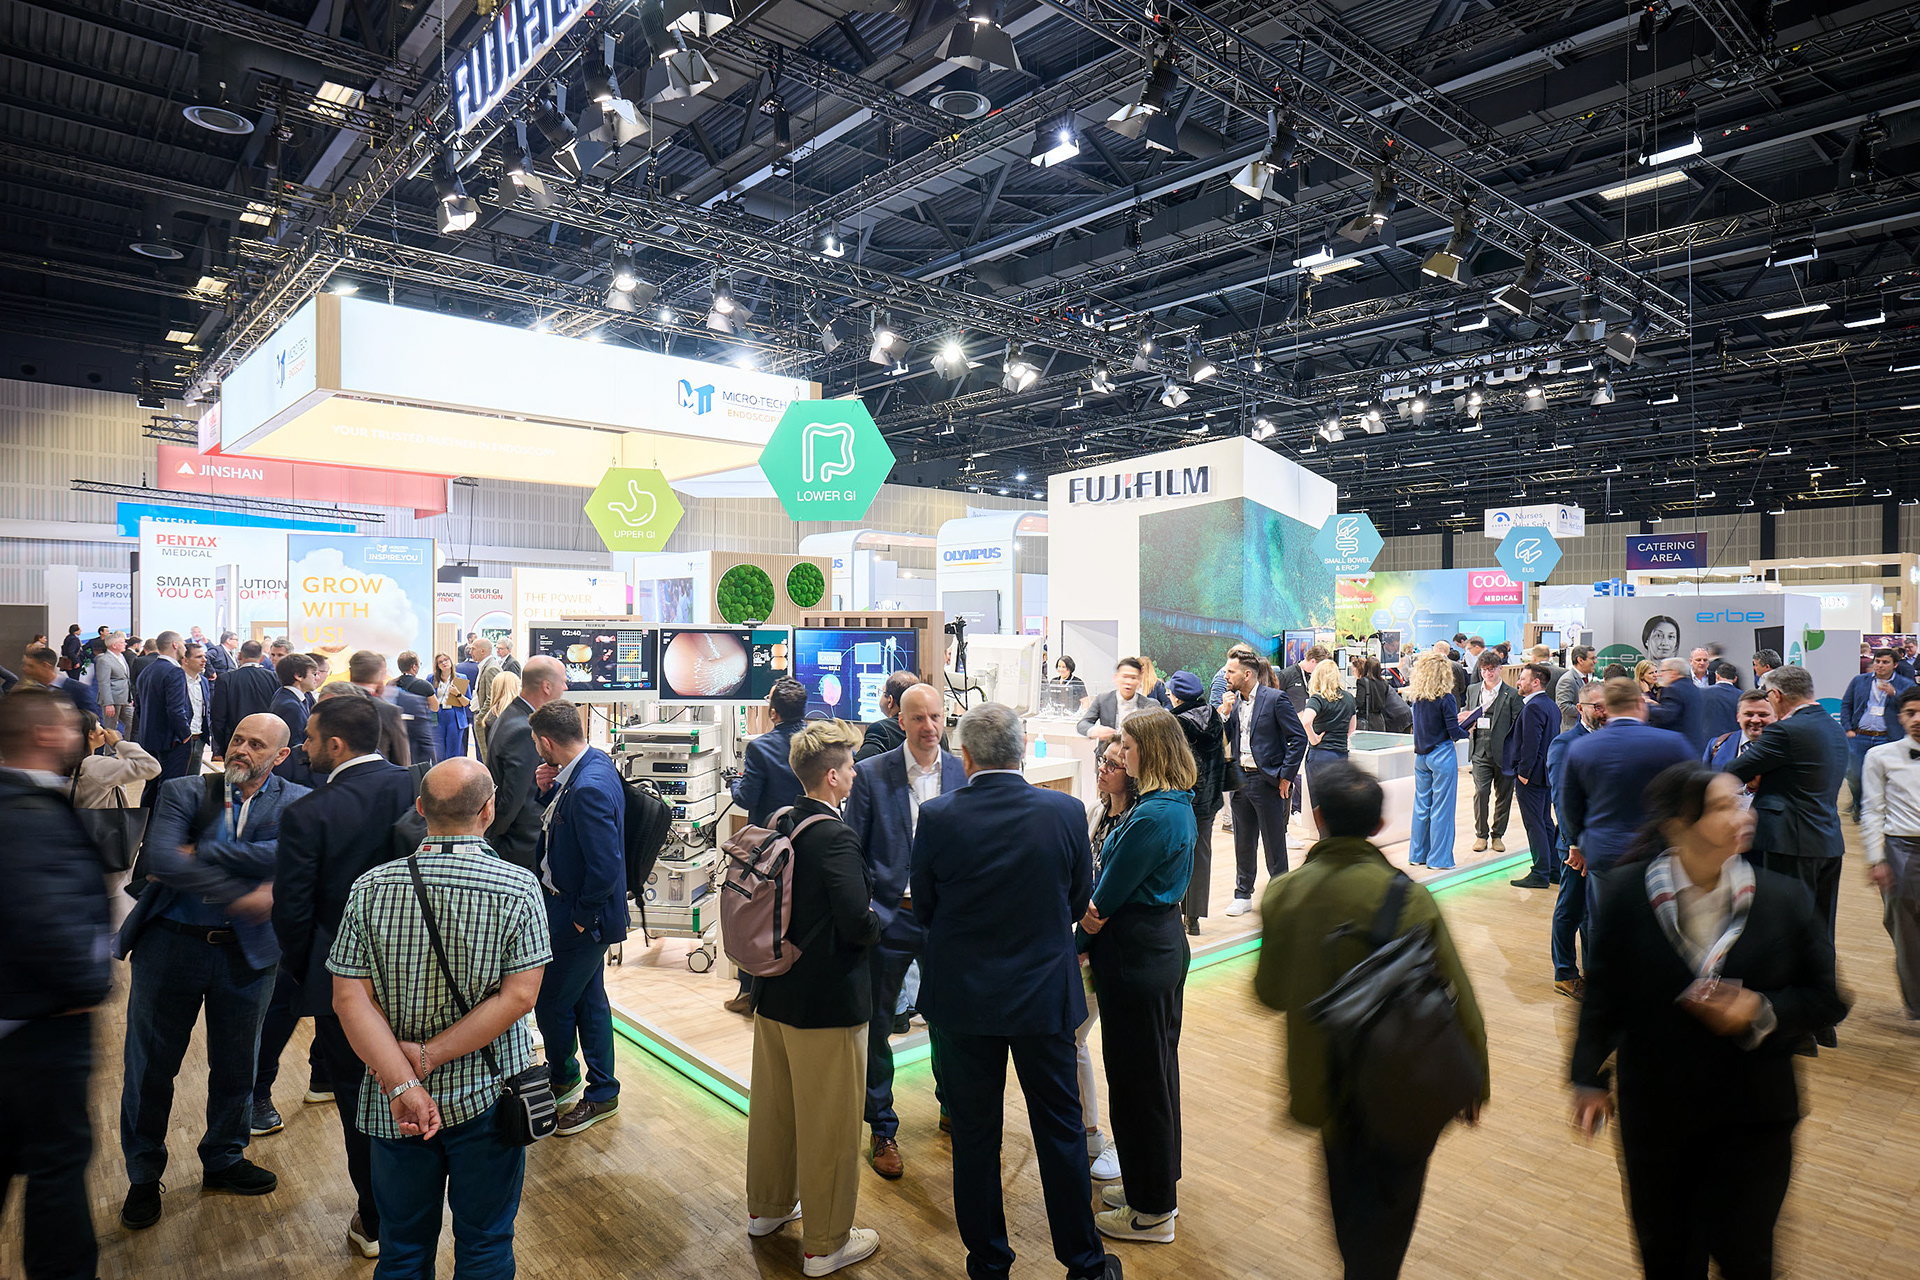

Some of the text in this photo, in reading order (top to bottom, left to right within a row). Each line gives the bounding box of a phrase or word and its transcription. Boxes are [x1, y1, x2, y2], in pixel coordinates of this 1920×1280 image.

[727, 409, 781, 423] ENDOSCOP
[331, 424, 368, 438] YOUR
[370, 428, 425, 444] TRUSTED
[427, 435, 476, 449] PARTNER
[199, 464, 263, 480] JINSHAN
[1069, 466, 1209, 503] FUJIFILM
[796, 490, 856, 502] LOWER GI
[156, 534, 217, 548] PENTAX
[613, 530, 656, 539] UPPER GI
[161, 548, 212, 558] MEDICAL
[1637, 541, 1695, 552] CATERING
[943, 547, 1001, 561] OLYMPUS
[1324, 556, 1371, 565] SMALL BOWEL
[1650, 553, 1682, 562] AREA
[156, 575, 211, 588] SMART
[302, 576, 383, 594] GROW
[157, 587, 189, 599] YOU
[524, 592, 592, 604] THE POWER
[1484, 594, 1518, 602] MEDICAL
[302, 601, 369, 618] WITH
[524, 608, 538, 618] OF
[1696, 609, 1765, 623] erbe
[302, 626, 343, 643] US!
